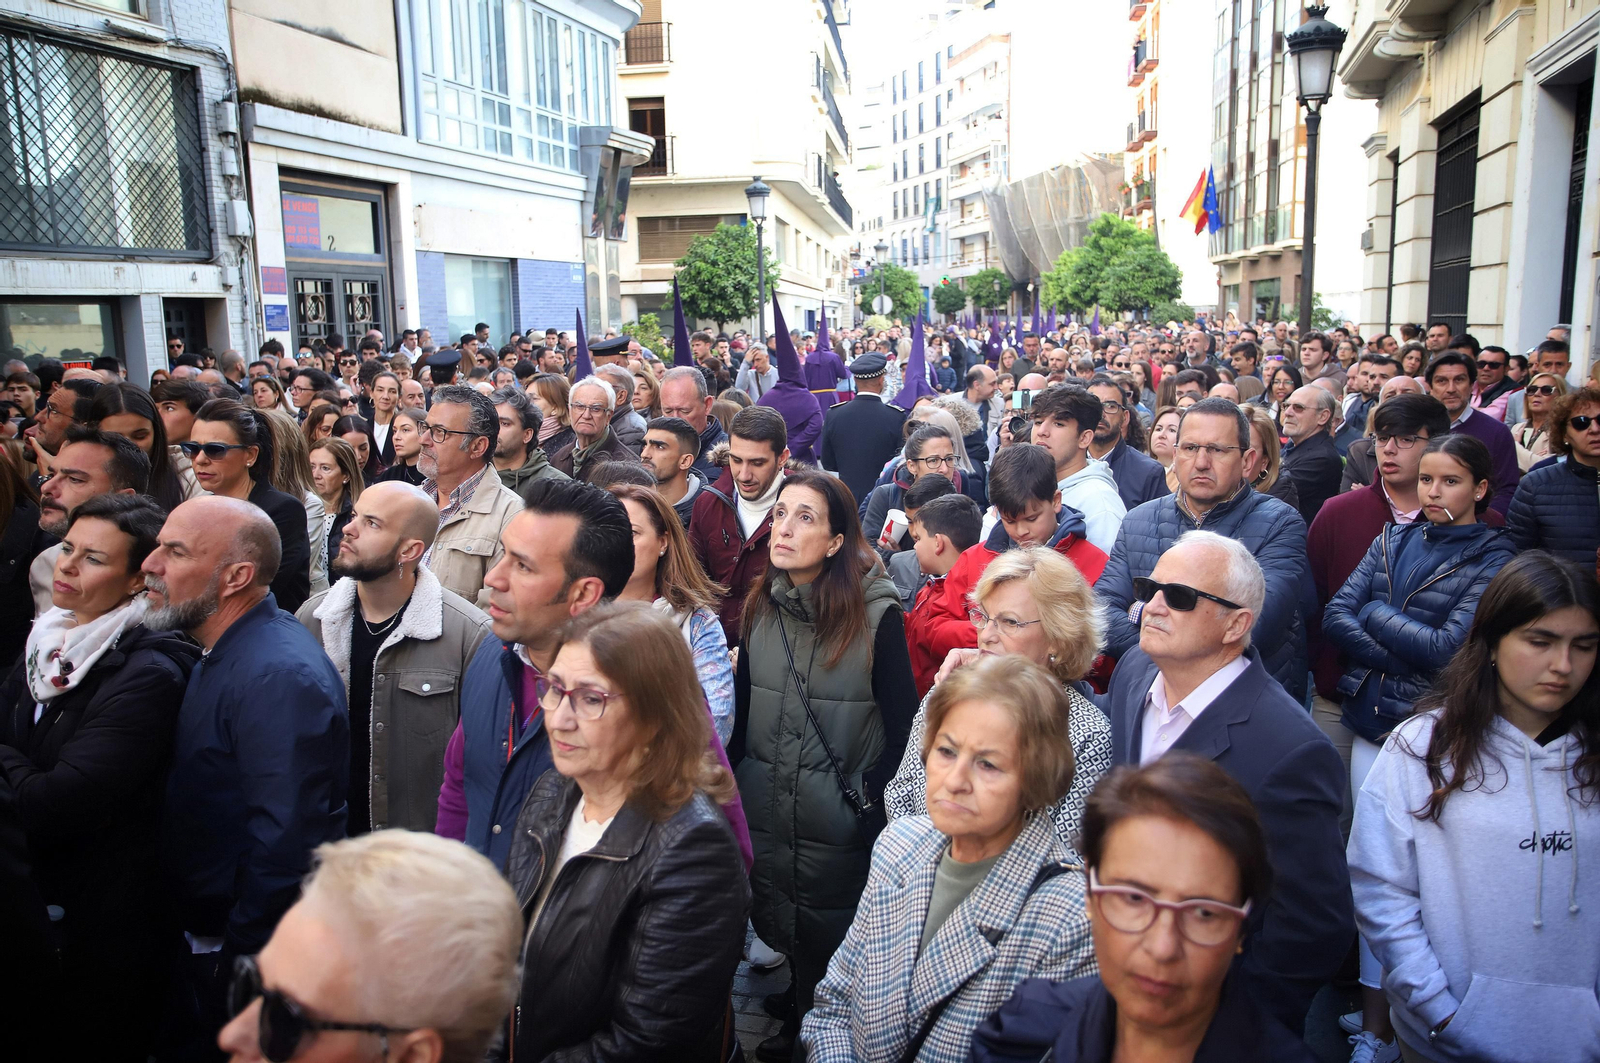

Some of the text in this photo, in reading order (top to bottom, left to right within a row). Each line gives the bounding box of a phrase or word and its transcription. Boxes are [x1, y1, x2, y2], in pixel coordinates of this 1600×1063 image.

[292, 200, 318, 214] VENDE
[327, 234, 336, 251] 2
[190, 270, 198, 284] 4
